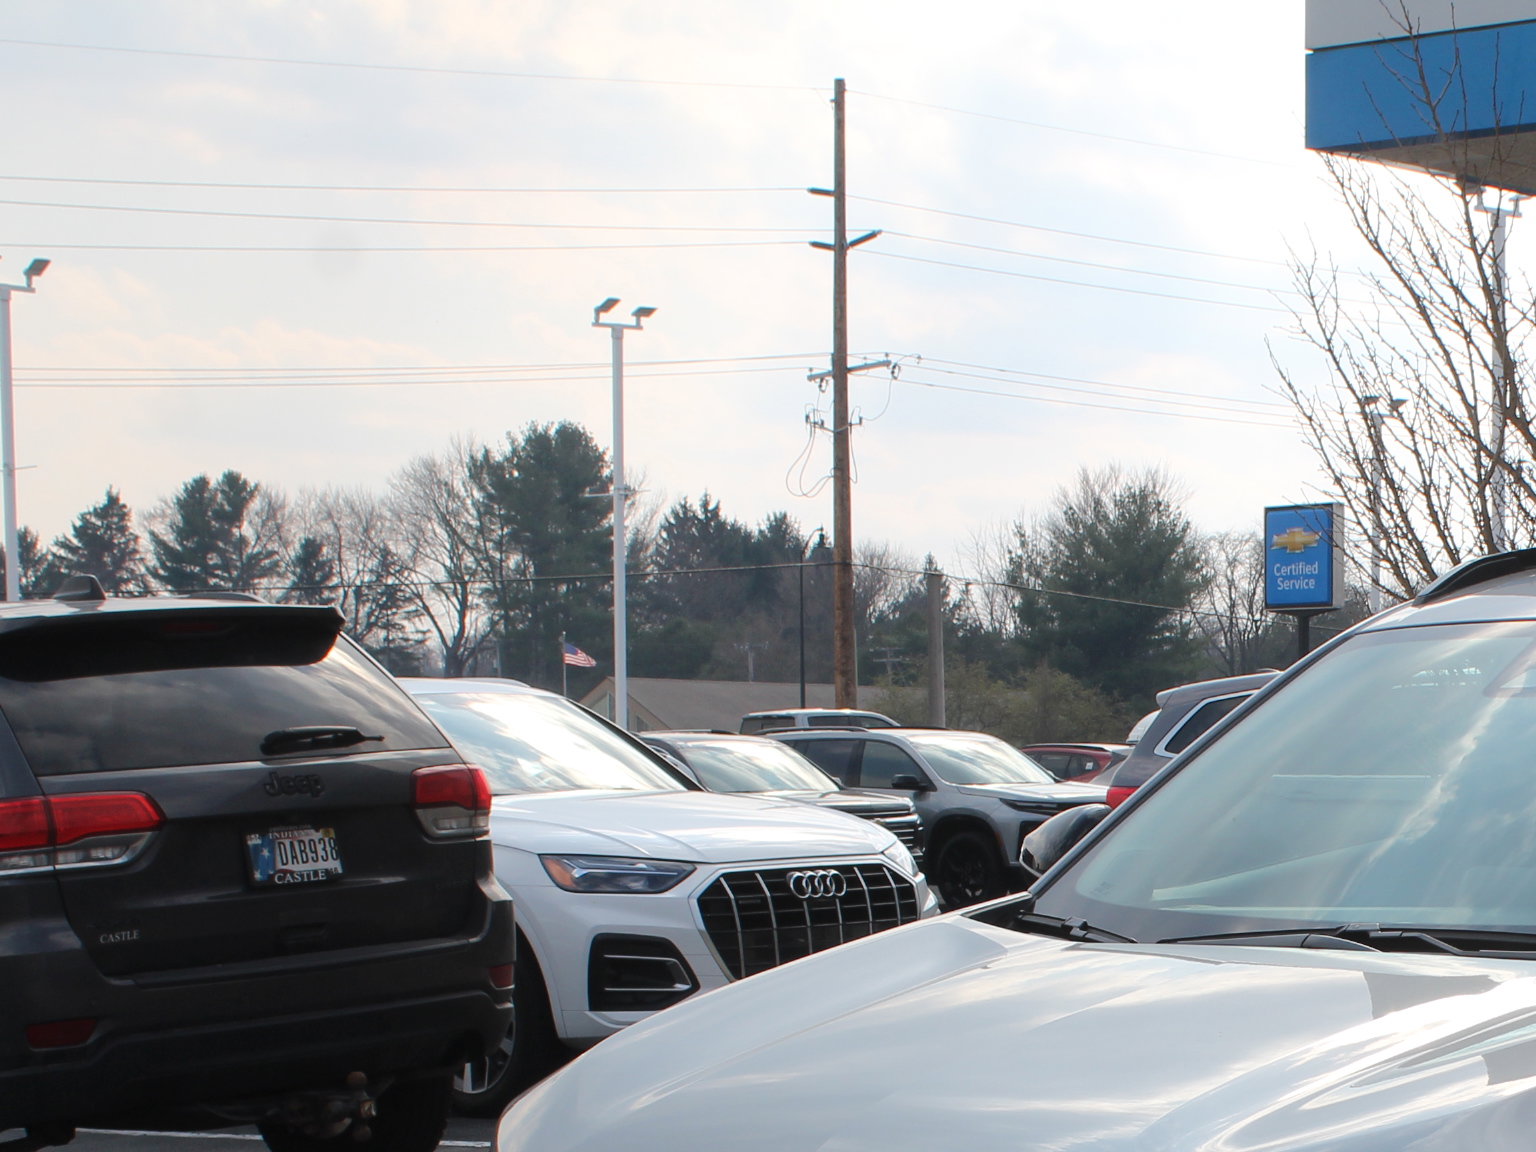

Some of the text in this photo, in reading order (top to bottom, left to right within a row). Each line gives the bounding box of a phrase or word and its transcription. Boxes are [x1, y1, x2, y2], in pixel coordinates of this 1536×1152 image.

[1274, 561, 1318, 576] Certified
[1277, 577, 1315, 590] Service
[264, 771, 325, 797] Jeep
[277, 838, 338, 867] DAB938
[275, 870, 326, 884] CASTLE
[99, 929, 140, 944] CASTLE
